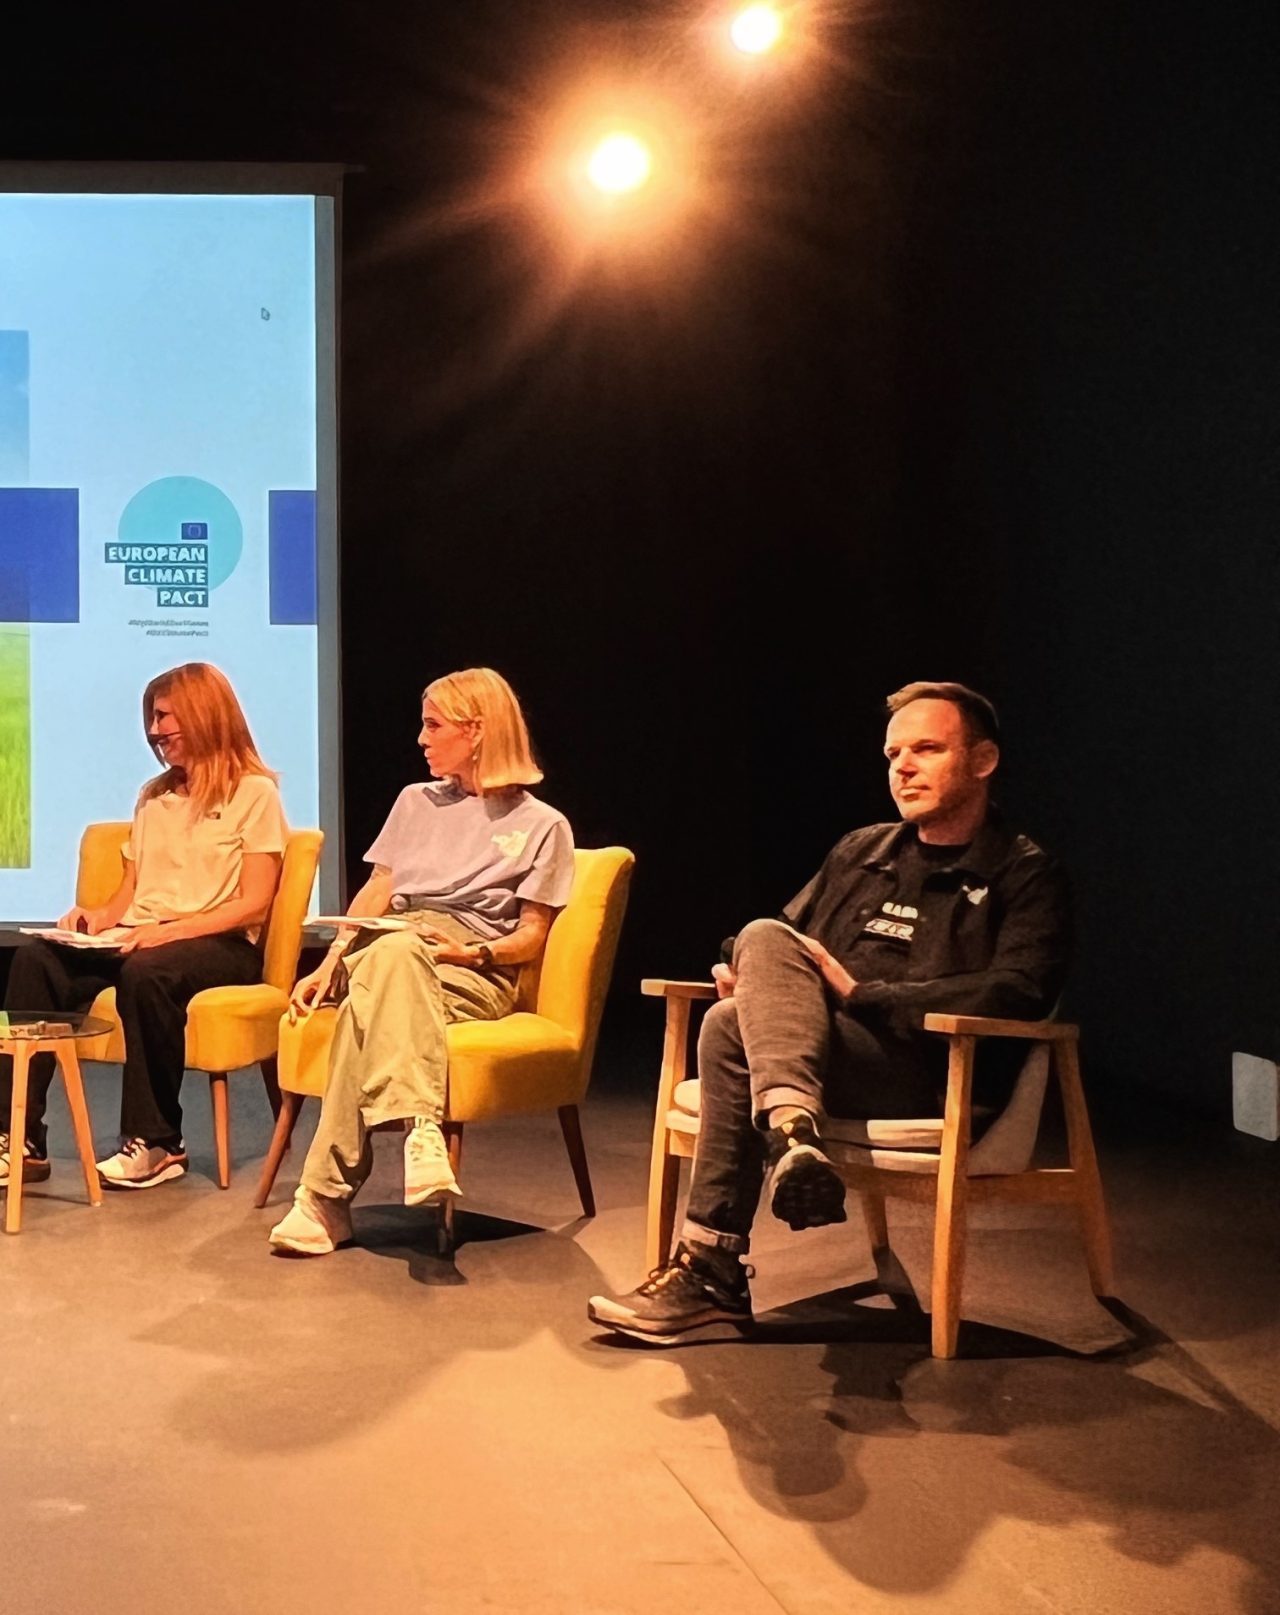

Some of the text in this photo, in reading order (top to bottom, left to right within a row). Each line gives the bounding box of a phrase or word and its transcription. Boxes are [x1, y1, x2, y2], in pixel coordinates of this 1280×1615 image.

[108, 547, 206, 562] EUROPEAN
[128, 568, 206, 584] CLIMATE
[160, 591, 206, 605] PACT
